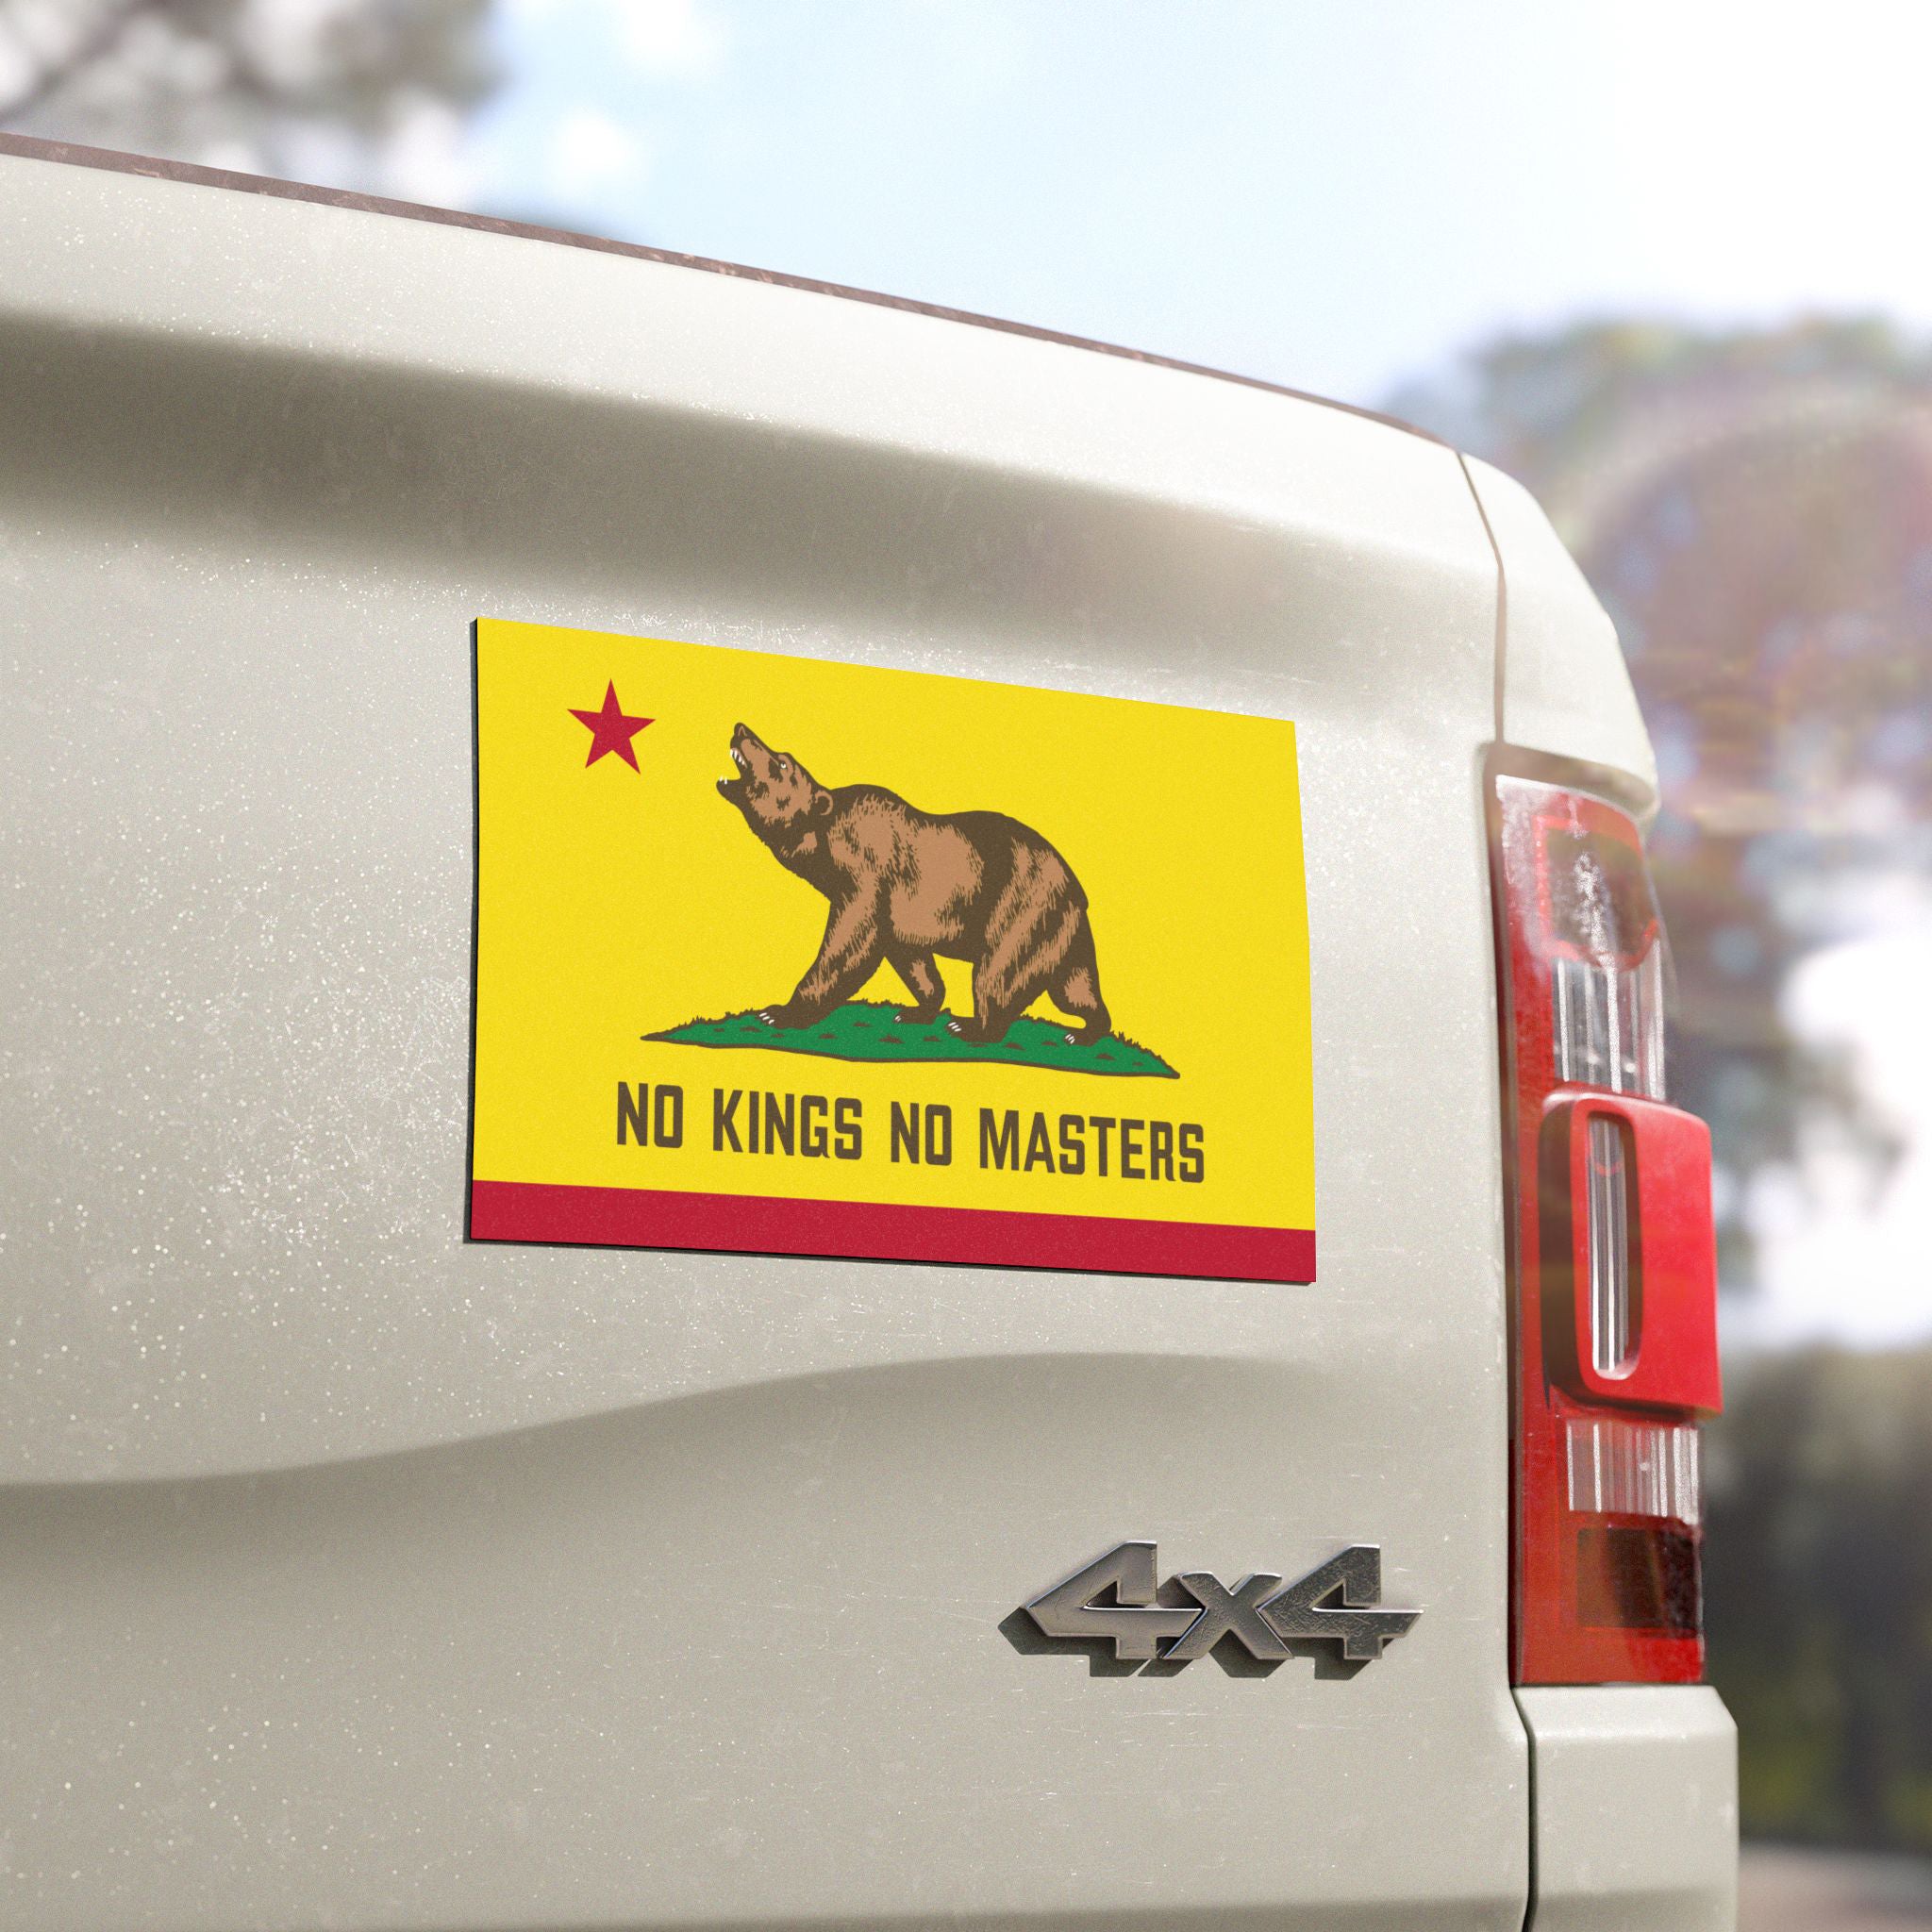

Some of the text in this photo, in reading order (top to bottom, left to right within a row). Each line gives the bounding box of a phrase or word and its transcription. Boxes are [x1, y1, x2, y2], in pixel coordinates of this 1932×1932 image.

[617, 1081, 1205, 1184] NO KINGS NO MASTERS
[1026, 1540, 1424, 1660] 4x4
